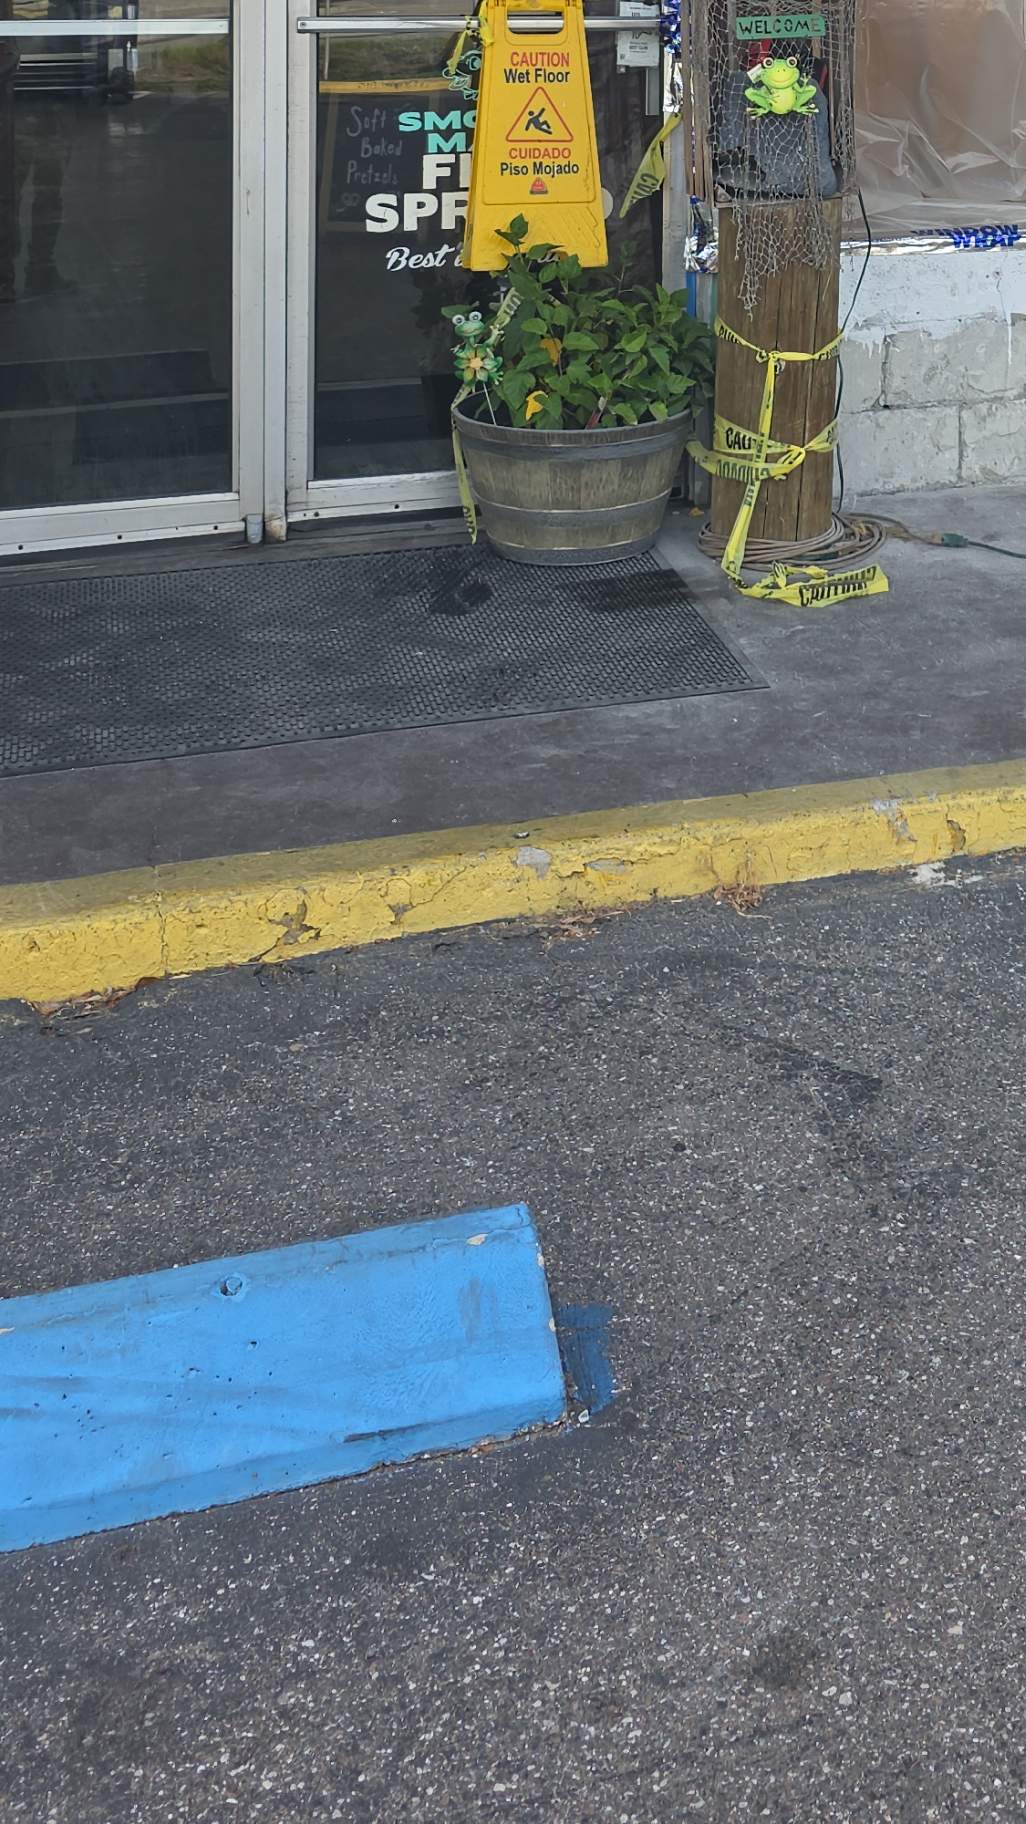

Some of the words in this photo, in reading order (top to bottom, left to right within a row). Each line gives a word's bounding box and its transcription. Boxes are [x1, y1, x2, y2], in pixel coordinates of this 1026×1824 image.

[738, 18, 821, 35] WELCOME
[510, 51, 570, 67] CAUTION
[504, 68, 530, 84] Wet
[534, 67, 571, 83] Floor
[508, 147, 572, 160] CUIDADO
[500, 162, 529, 176] Piso
[533, 160, 580, 178] Mojado
[385, 244, 456, 272] Best
